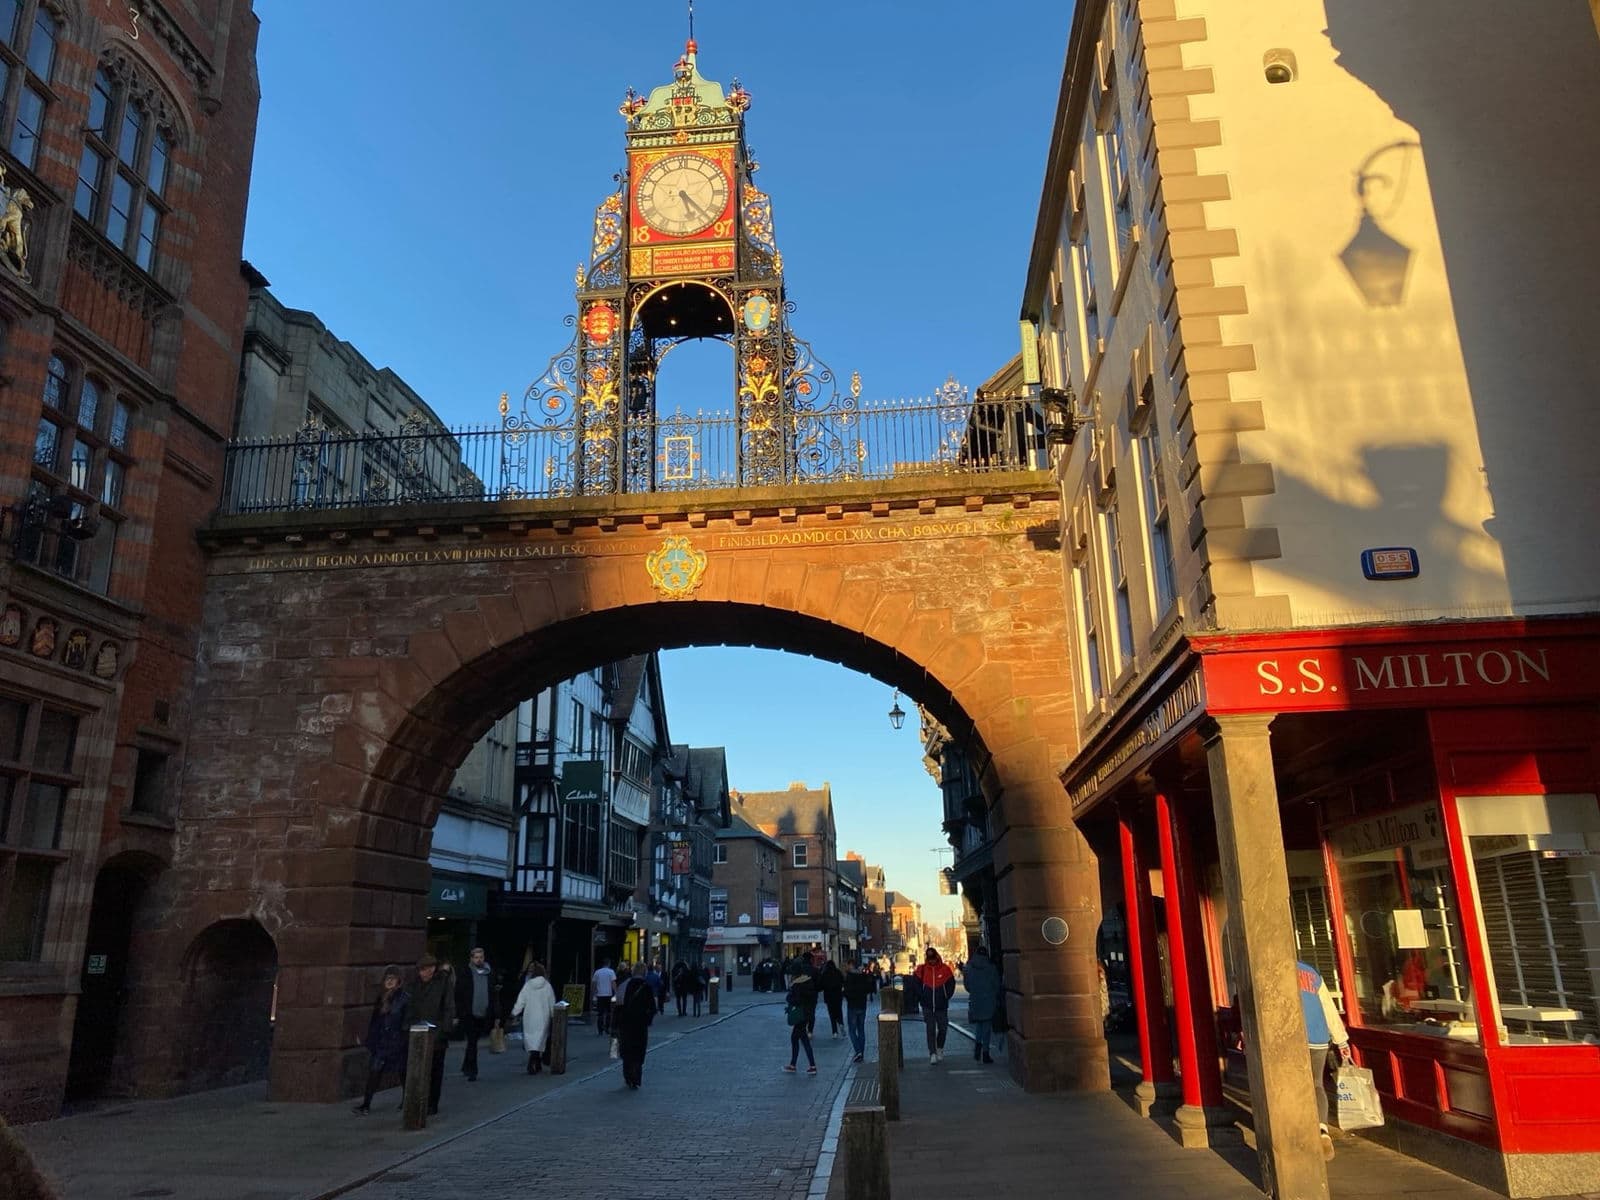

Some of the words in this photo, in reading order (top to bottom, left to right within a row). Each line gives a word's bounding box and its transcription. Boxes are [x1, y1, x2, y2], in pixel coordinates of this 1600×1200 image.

[632, 226, 650, 243] 18
[714, 219, 733, 238] 97
[316, 554, 358, 568] BEGUN
[464, 546, 496, 562] JOHN
[499, 544, 555, 558] KELSALL
[1256, 659, 1337, 695] S.S.
[1352, 649, 1551, 691] MILTON
[1376, 815, 1421, 850] Milton
